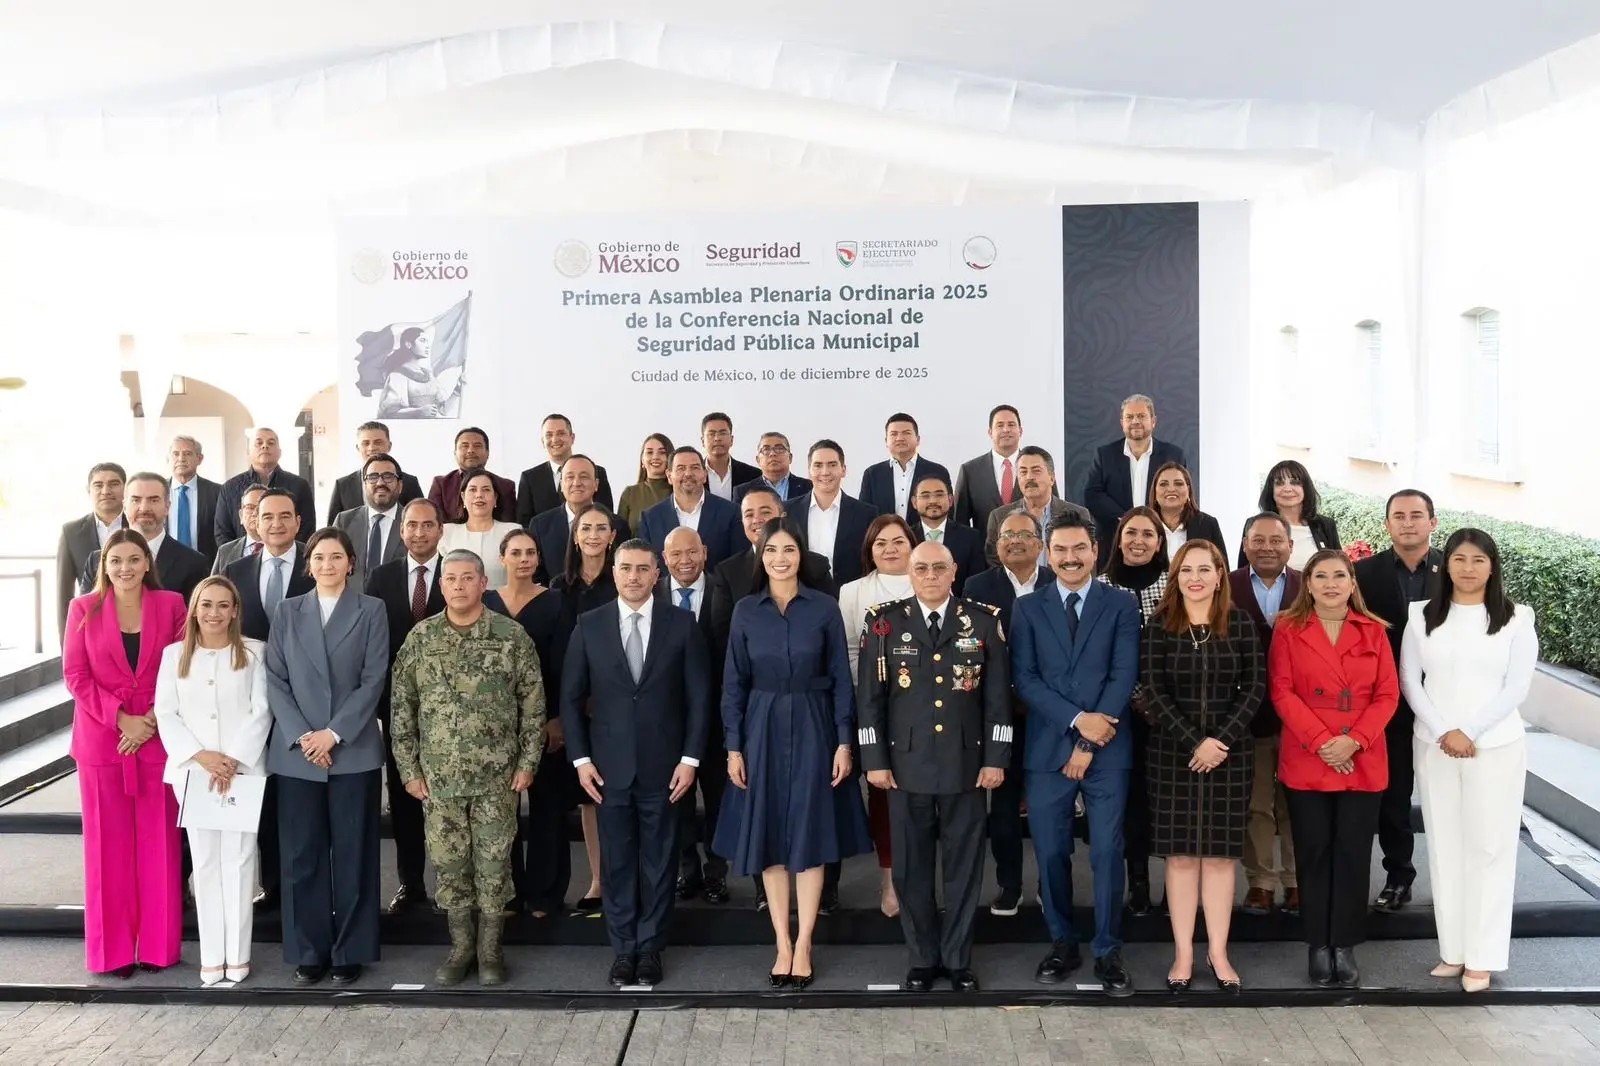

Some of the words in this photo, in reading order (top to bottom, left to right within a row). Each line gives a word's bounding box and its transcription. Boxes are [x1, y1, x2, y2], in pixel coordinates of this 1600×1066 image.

[598, 241, 660, 253] Gobierno
[663, 240, 680, 252] de
[706, 241, 801, 262] Seguridad
[862, 240, 938, 249] SECRETARIADO
[863, 249, 916, 258] EJECUTIVO
[392, 250, 451, 261] Gobierno
[454, 250, 469, 260] de
[598, 253, 680, 274] México
[393, 261, 469, 280] México
[562, 289, 641, 306] Primera
[648, 288, 743, 304] Asamblea
[750, 287, 832, 303] Plenaria
[840, 285, 934, 301] Ordinaria
[944, 285, 988, 299] 2025
[626, 312, 647, 328] de
[656, 312, 672, 327] la
[680, 310, 800, 327] Conferencia
[808, 308, 893, 326] Nacional
[900, 307, 924, 325] de
[638, 336, 735, 356] Seguridad
[743, 334, 816, 351] Pública
[823, 332, 920, 352] Municipal
[632, 369, 678, 382] Ciudad
[683, 369, 699, 382] de
[704, 369, 757, 383] México,
[762, 370, 775, 381] 10
[780, 369, 796, 381] de
[801, 368, 870, 380] diciembre
[875, 368, 892, 379] de
[897, 368, 928, 379] 2025
